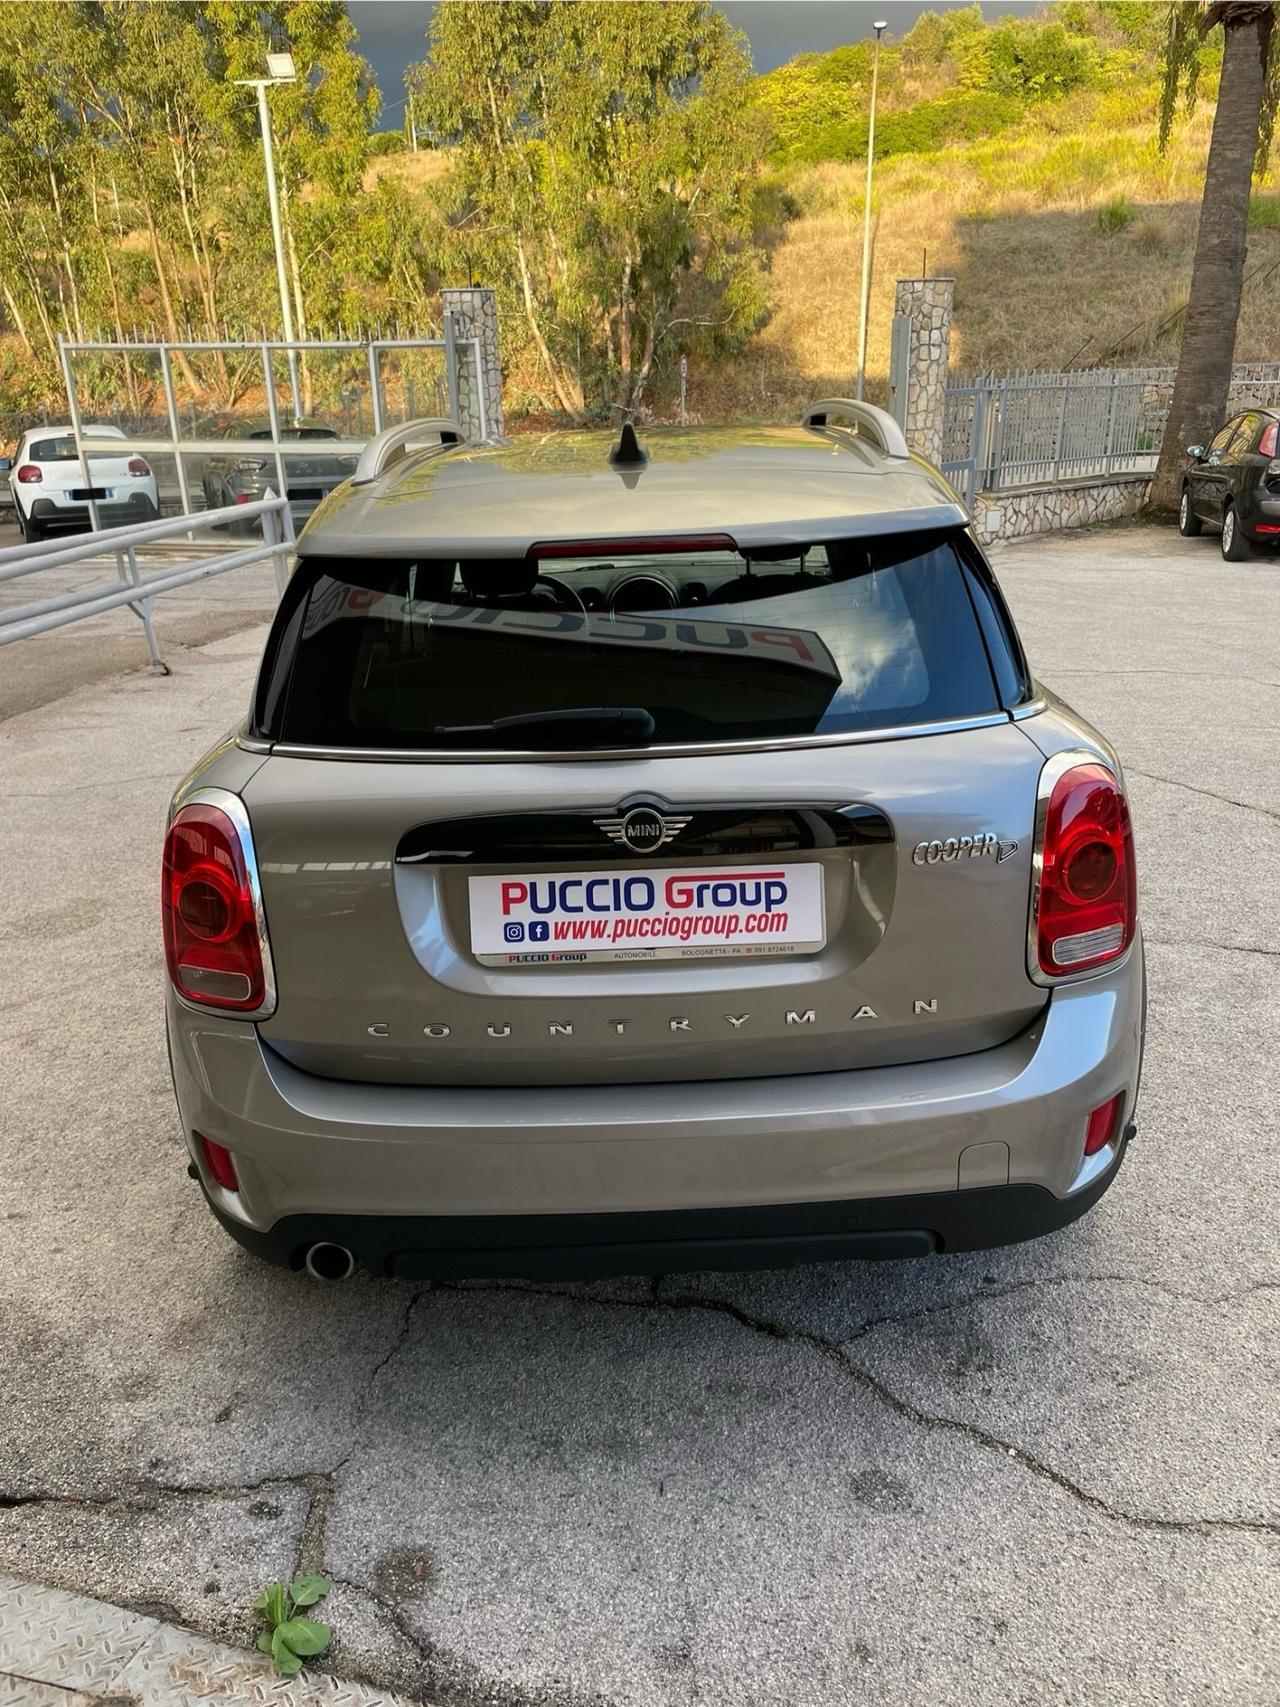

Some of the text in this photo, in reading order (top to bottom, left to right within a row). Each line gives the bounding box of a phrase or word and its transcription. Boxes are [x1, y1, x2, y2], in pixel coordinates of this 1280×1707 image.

[627, 823, 660, 838] MINI
[912, 832, 1019, 866] COOPER D
[501, 872, 788, 916] PUCCIO Group
[553, 911, 789, 944] www.pucciogroup.com
[508, 953, 549, 963] PUCCIO
[614, 951, 656, 959] AUTOMOBILI
[681, 948, 726, 956] BOLOGNETTA
[366, 998, 938, 1039] COUNTRYMAN
